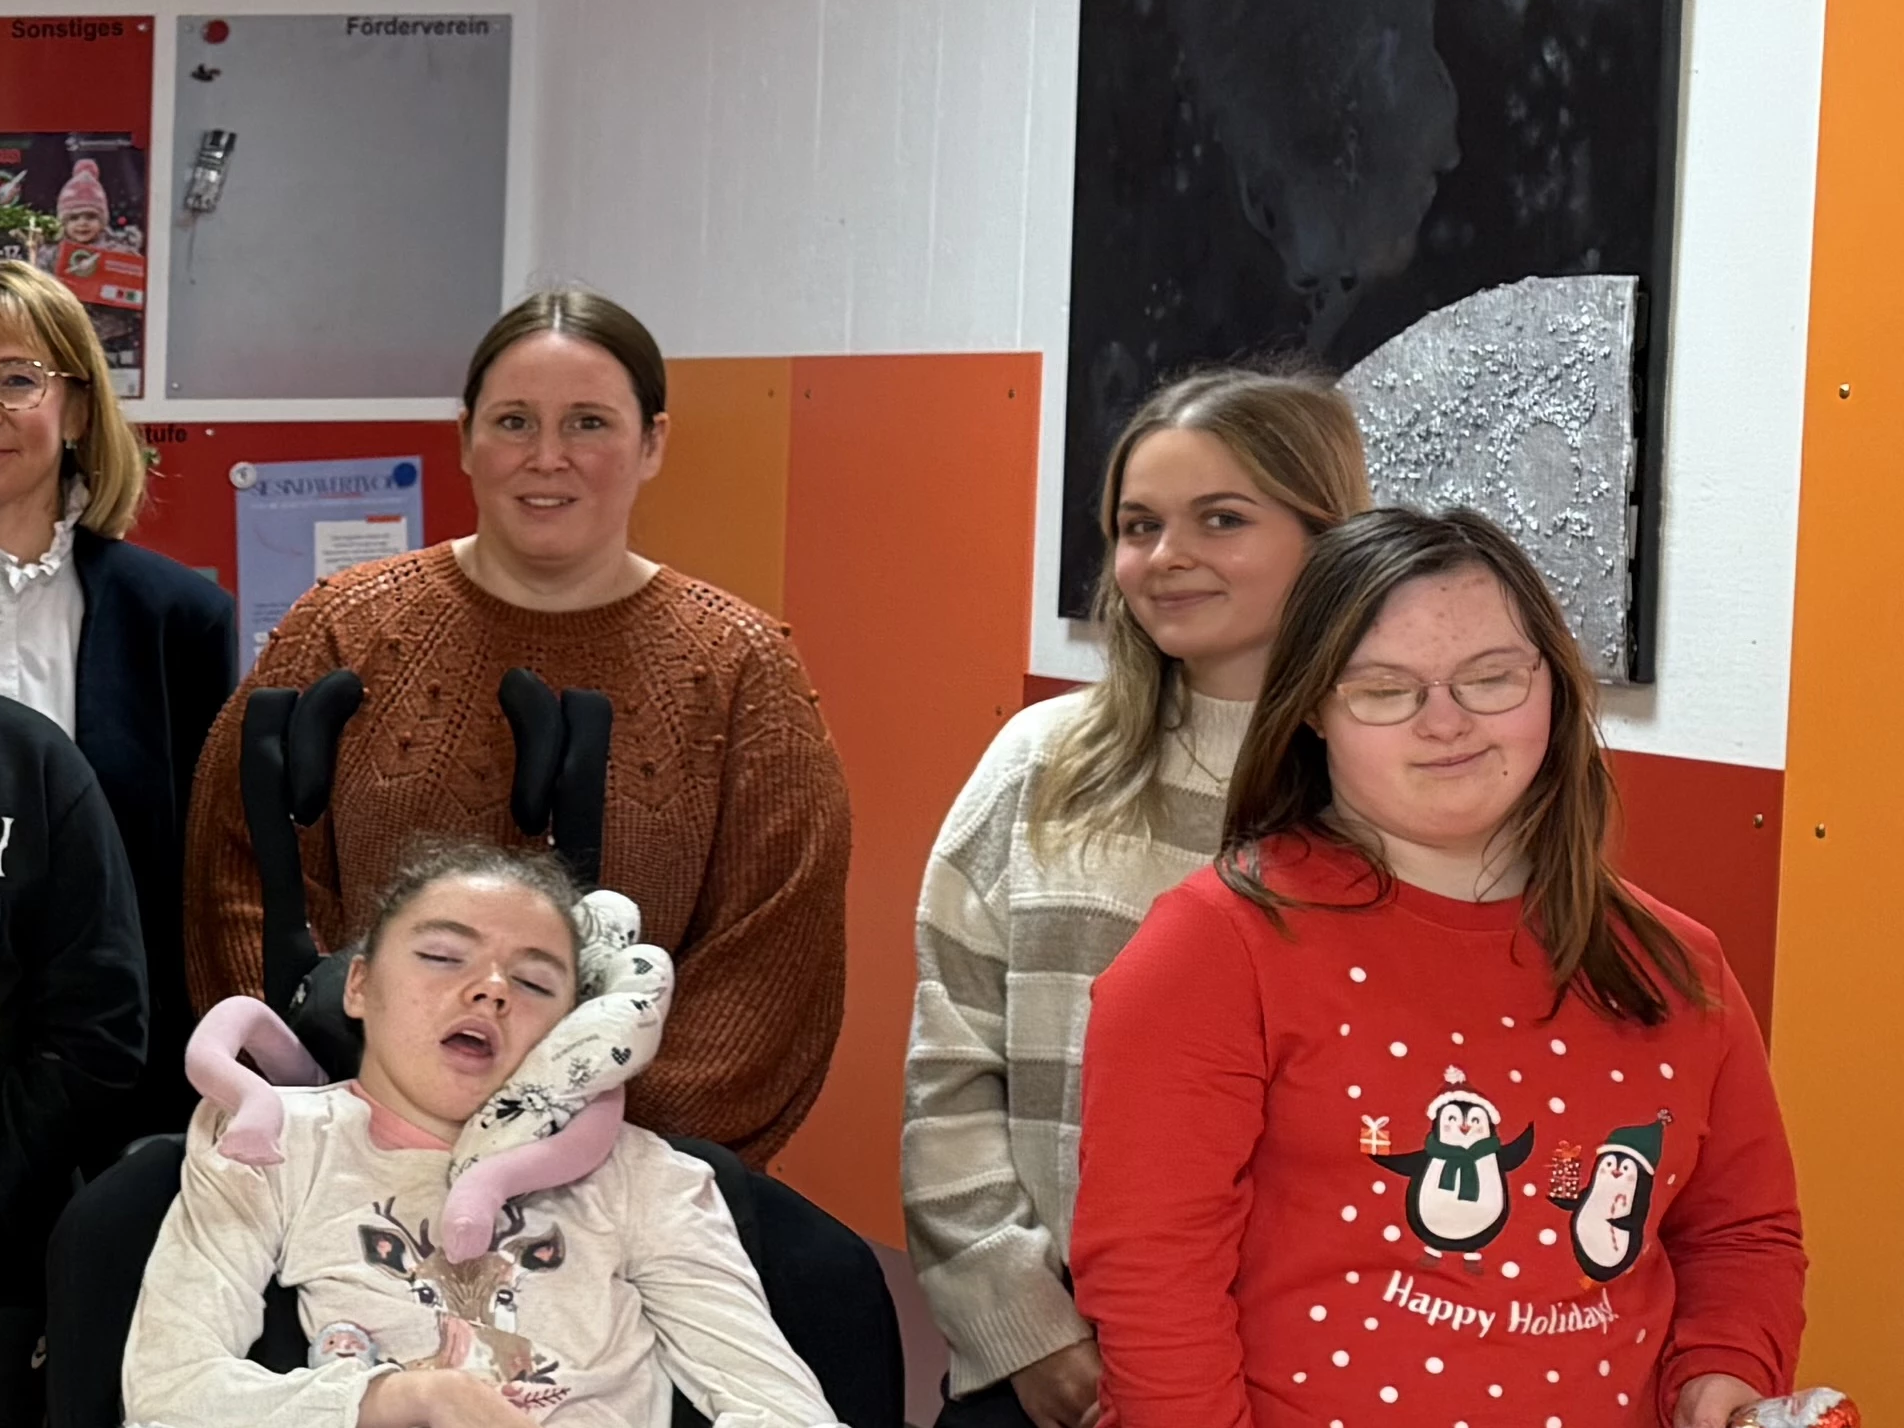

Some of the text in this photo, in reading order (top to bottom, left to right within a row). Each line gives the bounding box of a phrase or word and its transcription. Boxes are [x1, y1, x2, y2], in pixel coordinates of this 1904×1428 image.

[10, 18, 124, 42] Sonstiges
[346, 16, 490, 37] Förderverein
[1382, 1269, 1496, 1339] Happy
